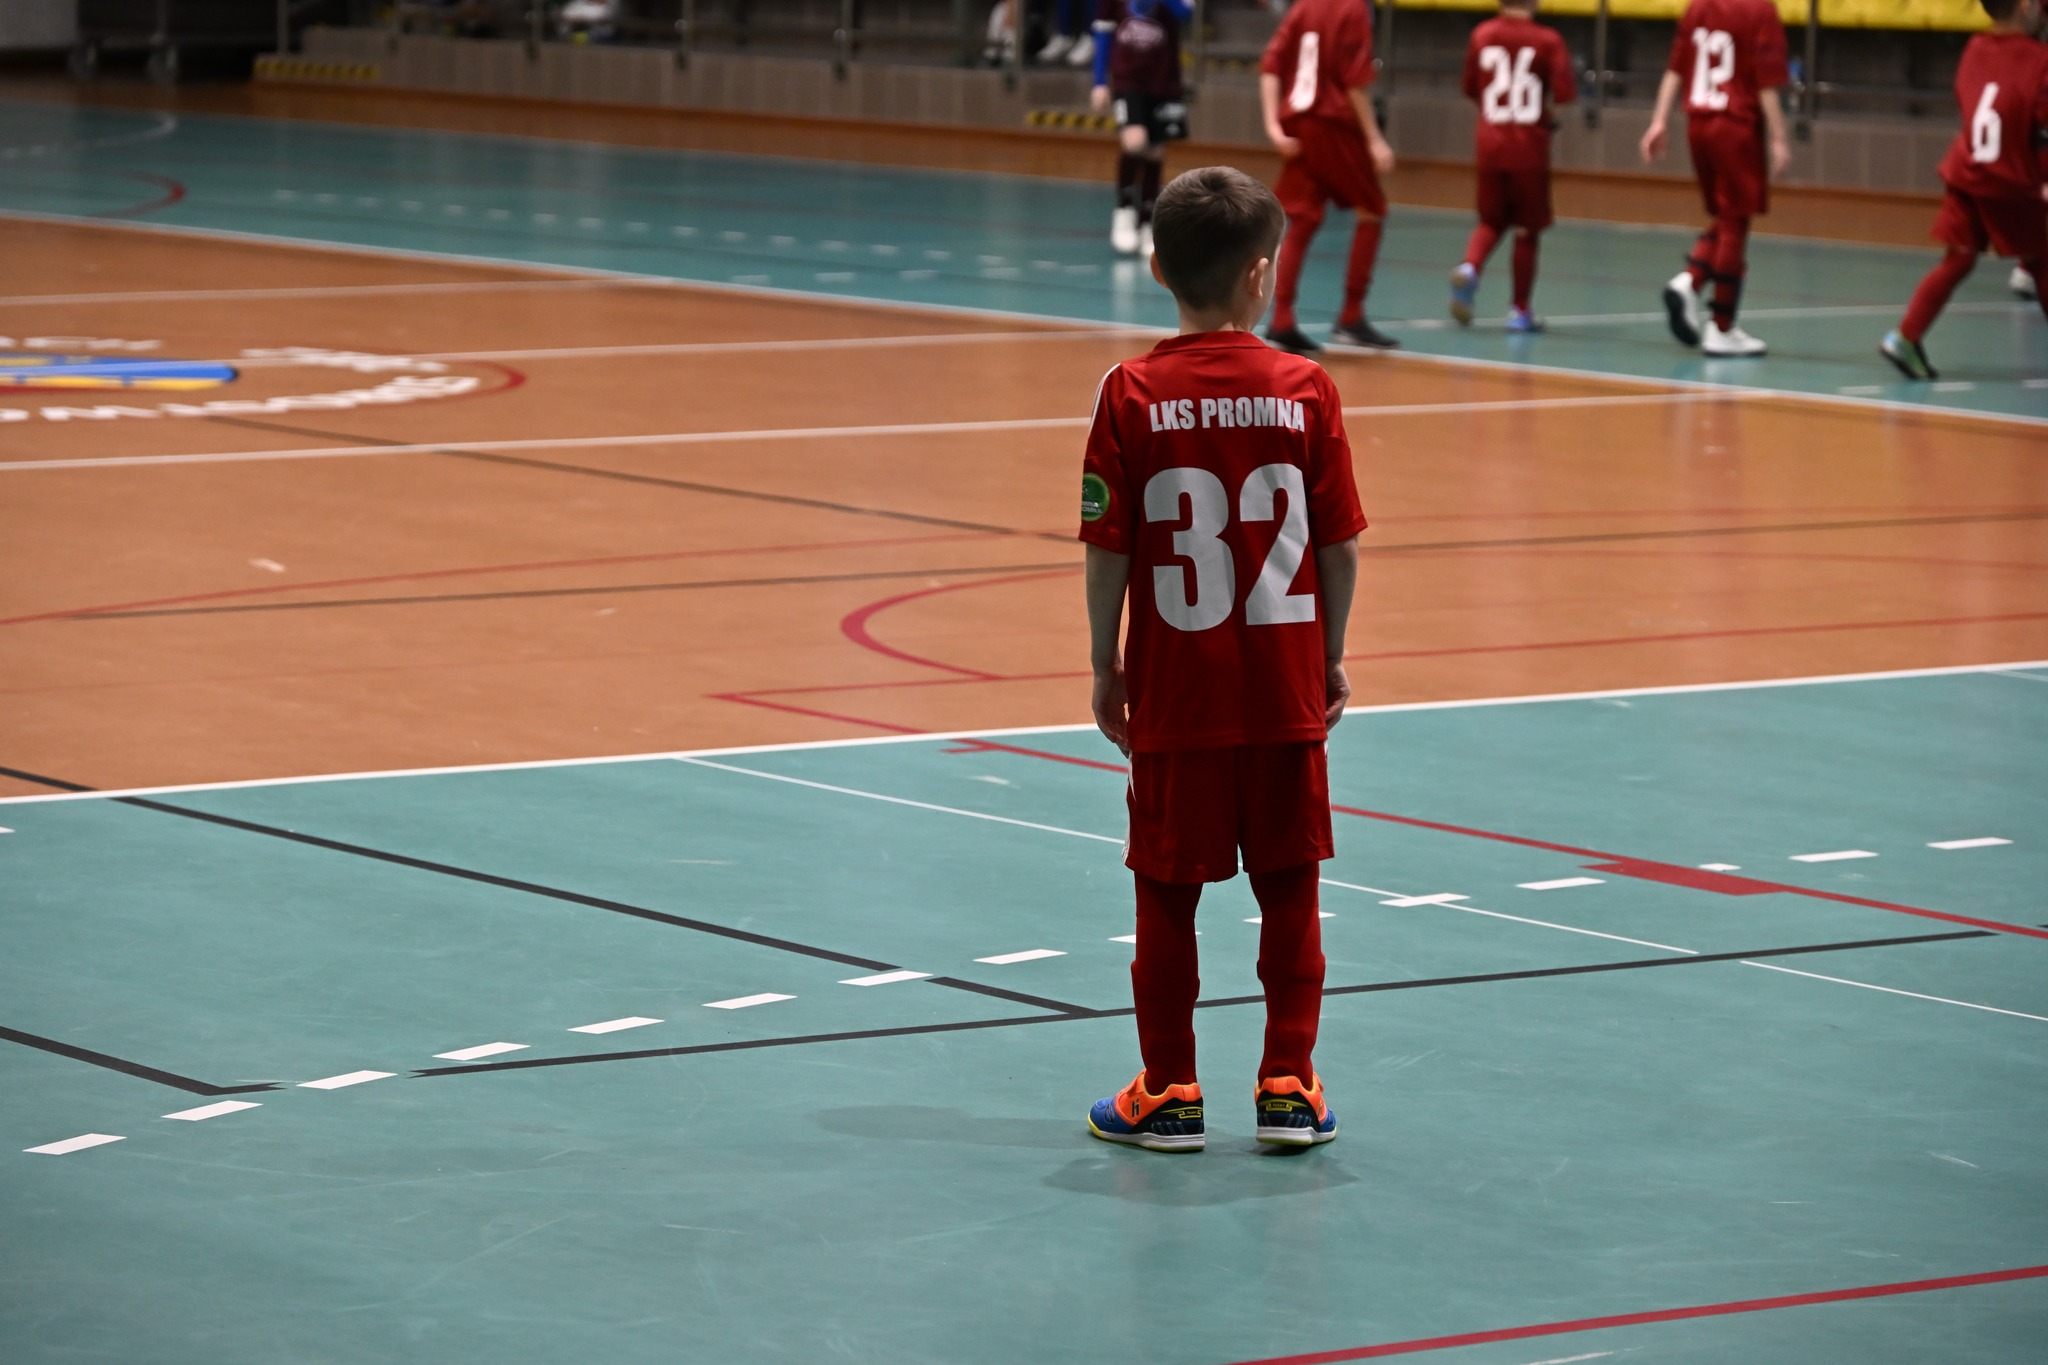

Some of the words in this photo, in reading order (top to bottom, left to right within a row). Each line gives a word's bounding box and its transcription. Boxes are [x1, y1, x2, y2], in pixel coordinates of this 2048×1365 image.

[1479, 45, 1543, 125] 26
[1689, 26, 1736, 111] 12
[1971, 81, 2003, 164] 6
[1149, 398, 1196, 433] LKS
[1200, 396, 1306, 433] PROMNA
[1143, 463, 1316, 632] 32
